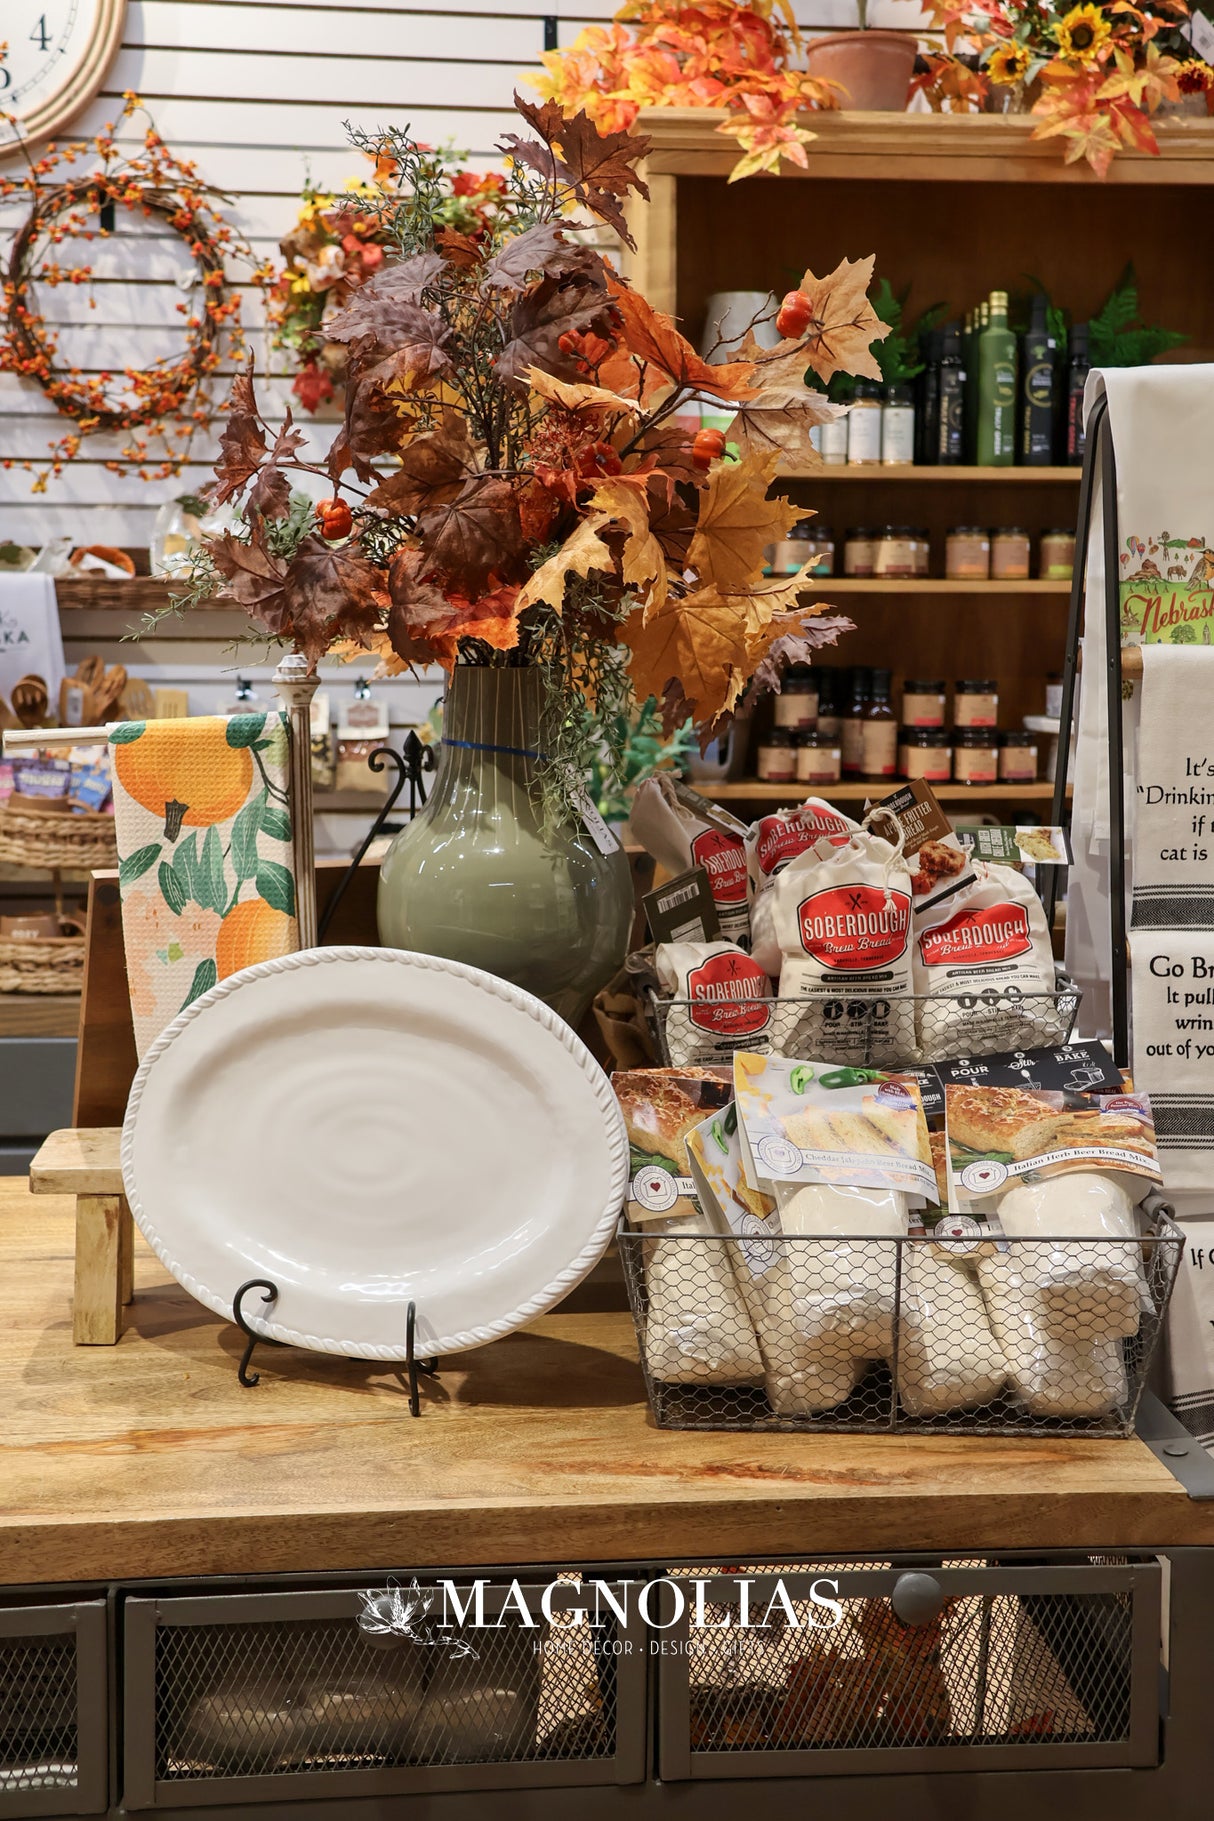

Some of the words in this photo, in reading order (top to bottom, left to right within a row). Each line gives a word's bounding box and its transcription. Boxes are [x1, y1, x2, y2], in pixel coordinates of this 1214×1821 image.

[30, 14, 53, 51] 4
[903, 801, 932, 826] FRITTER
[1192, 815, 1206, 837] if
[1160, 848, 1187, 861] cat
[1192, 843, 1208, 861] is
[803, 909, 907, 941] SOBERDOUGH
[823, 941, 855, 954] Brew
[857, 937, 892, 950] Bread
[1149, 955, 1184, 978] Go
[1167, 986, 1180, 1004] It
[1175, 1014, 1214, 1031] wrin
[1054, 1051, 1090, 1062] BAKE
[1146, 1043, 1173, 1057] out
[1176, 1039, 1192, 1059] of
[1195, 1044, 1214, 1059] yo
[951, 1066, 989, 1077] POUR
[1008, 1059, 1036, 1070] Stir
[805, 1153, 840, 1163] Cheddar
[1013, 1158, 1043, 1171] Italian
[1046, 1151, 1070, 1162] Herb
[1098, 1149, 1126, 1158] Bread
[1191, 1248, 1205, 1270] If
